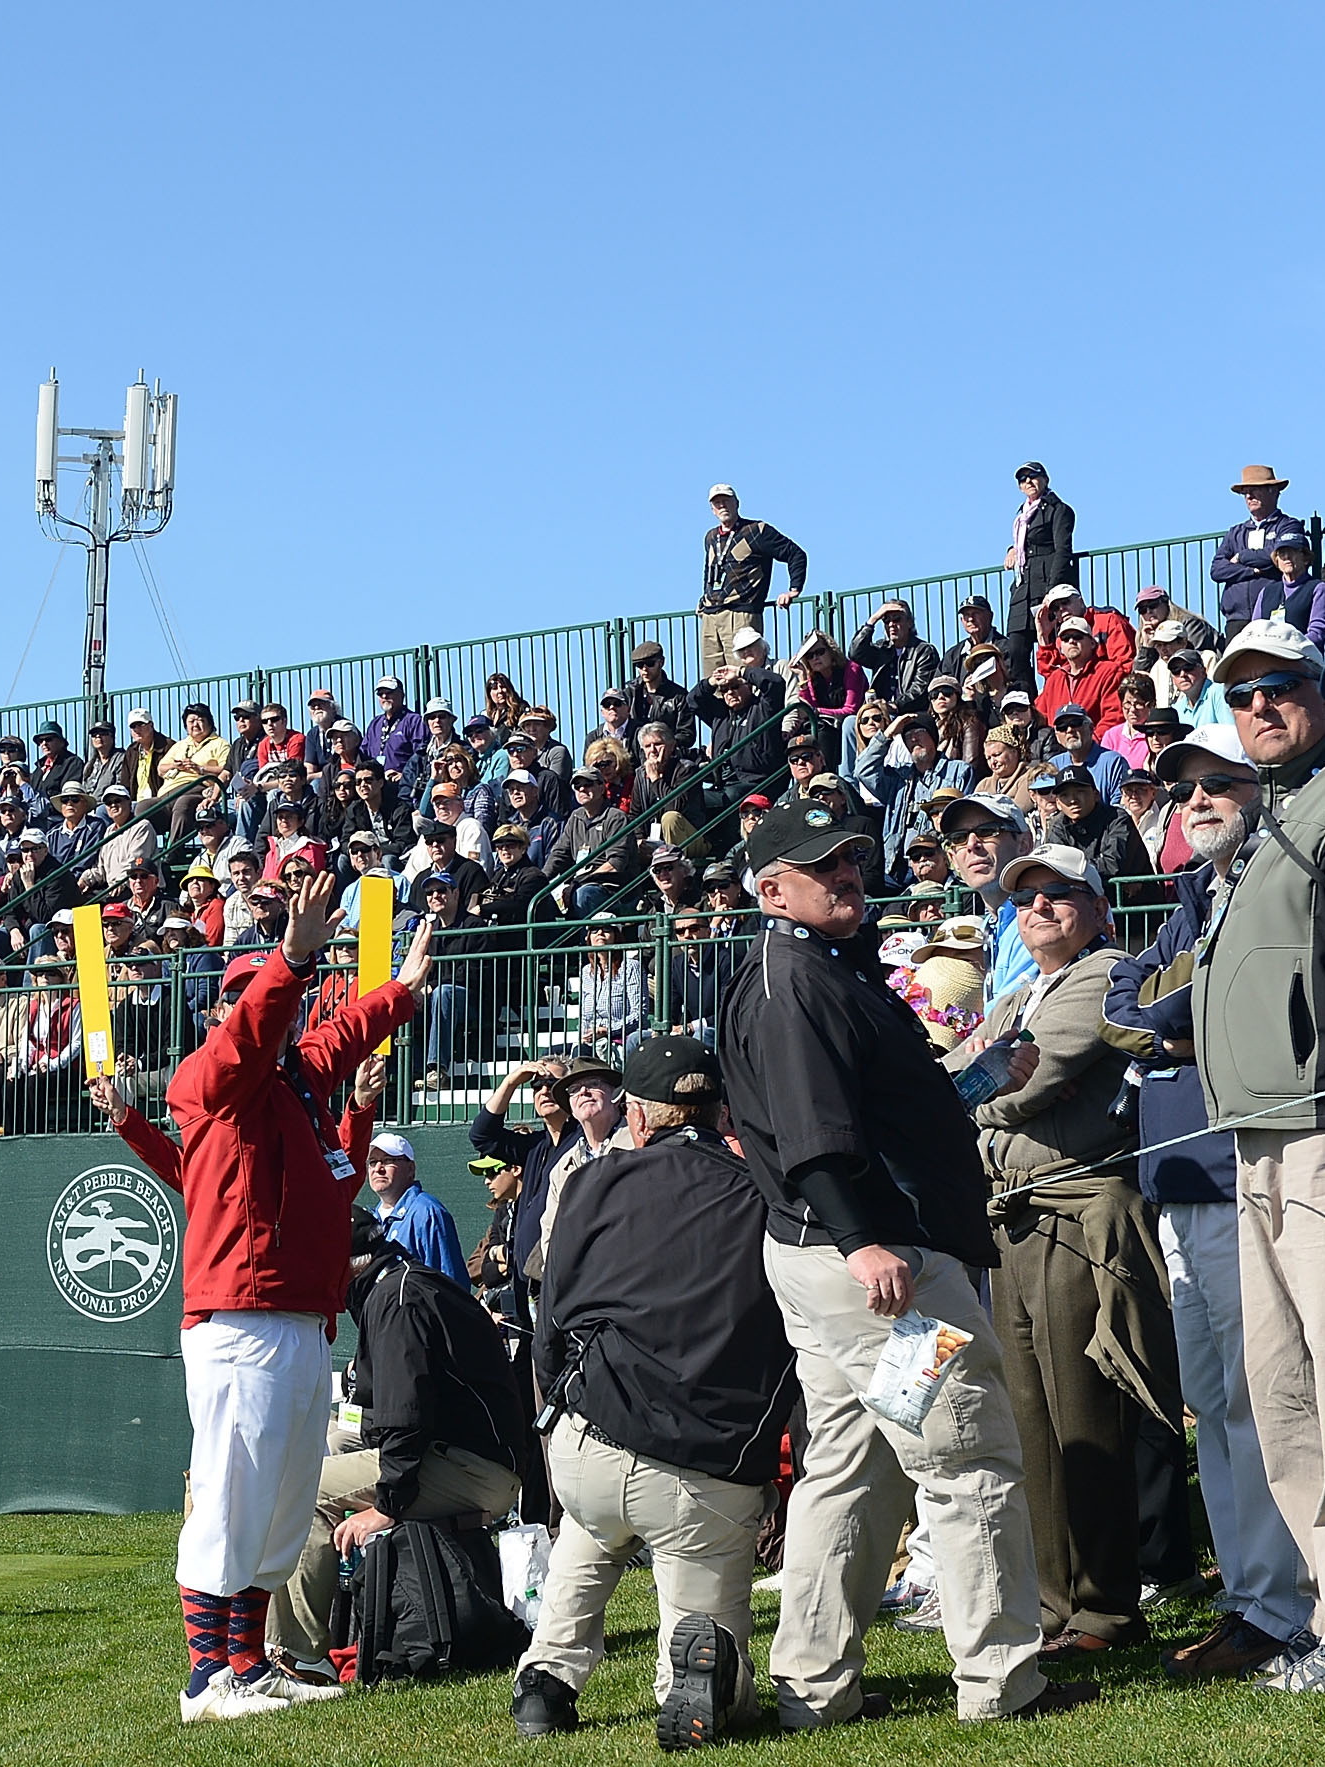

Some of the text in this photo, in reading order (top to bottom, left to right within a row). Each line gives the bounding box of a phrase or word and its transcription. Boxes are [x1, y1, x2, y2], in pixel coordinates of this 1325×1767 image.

[54, 1173, 173, 1235] AT&T PEBBLE BEACH
[54, 1257, 170, 1313] NATIONAL PRO-AM
